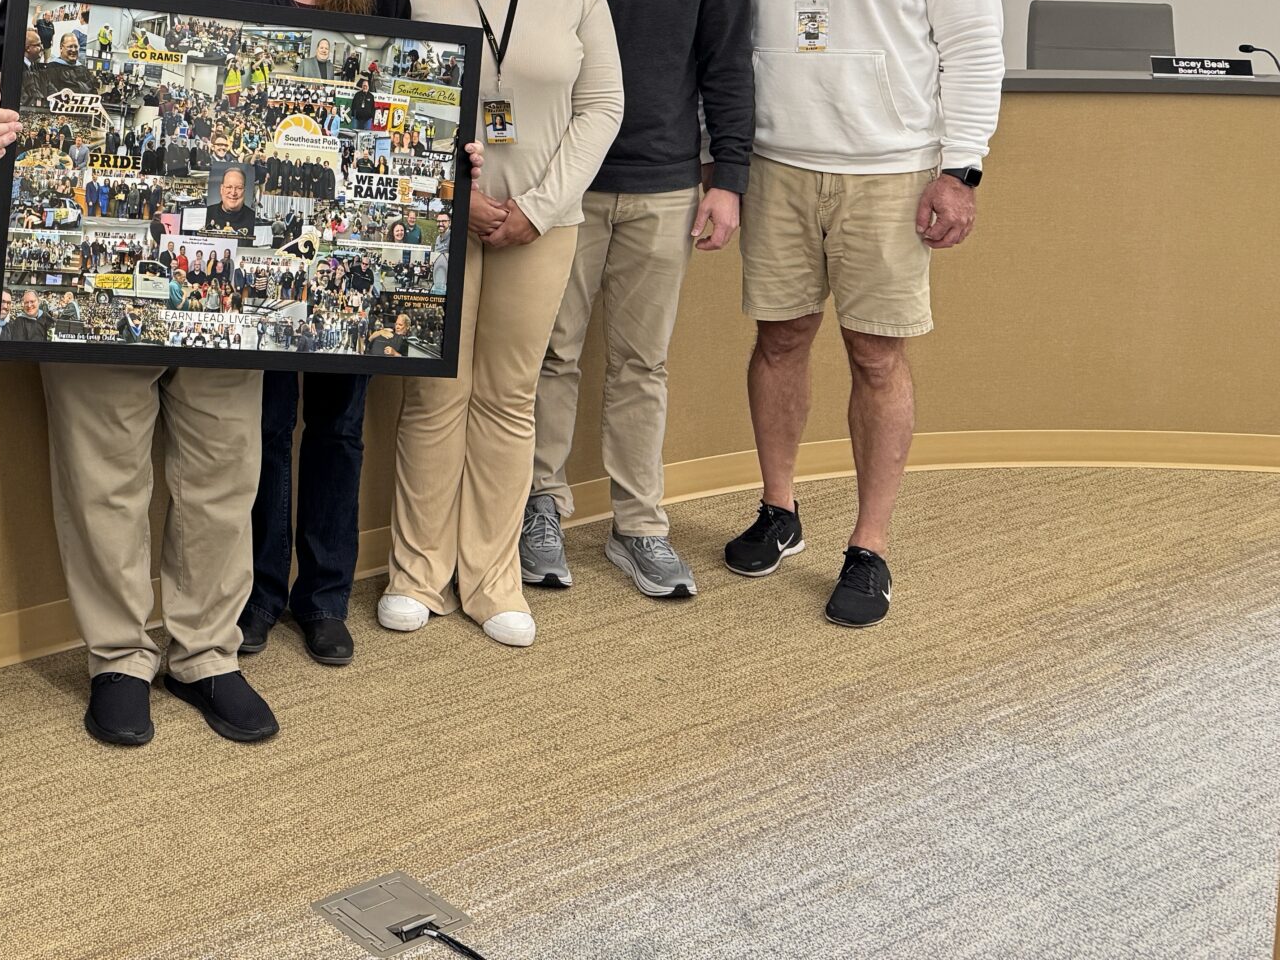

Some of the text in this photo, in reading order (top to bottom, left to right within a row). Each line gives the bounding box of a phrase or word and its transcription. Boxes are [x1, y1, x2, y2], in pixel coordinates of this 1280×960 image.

[131, 50, 184, 63] GO RAMS!
[1172, 58, 1230, 69] Lacey Beals
[1198, 68, 1227, 76] Reporter
[397, 84, 457, 102] Southeast Polk
[52, 100, 100, 113] Rams
[284, 134, 338, 146] Southeast Polk
[88, 153, 141, 169] PRIDE
[355, 175, 399, 187] WE ARE
[353, 185, 398, 201] RAMS
[393, 294, 429, 302] OUTSTANDING
